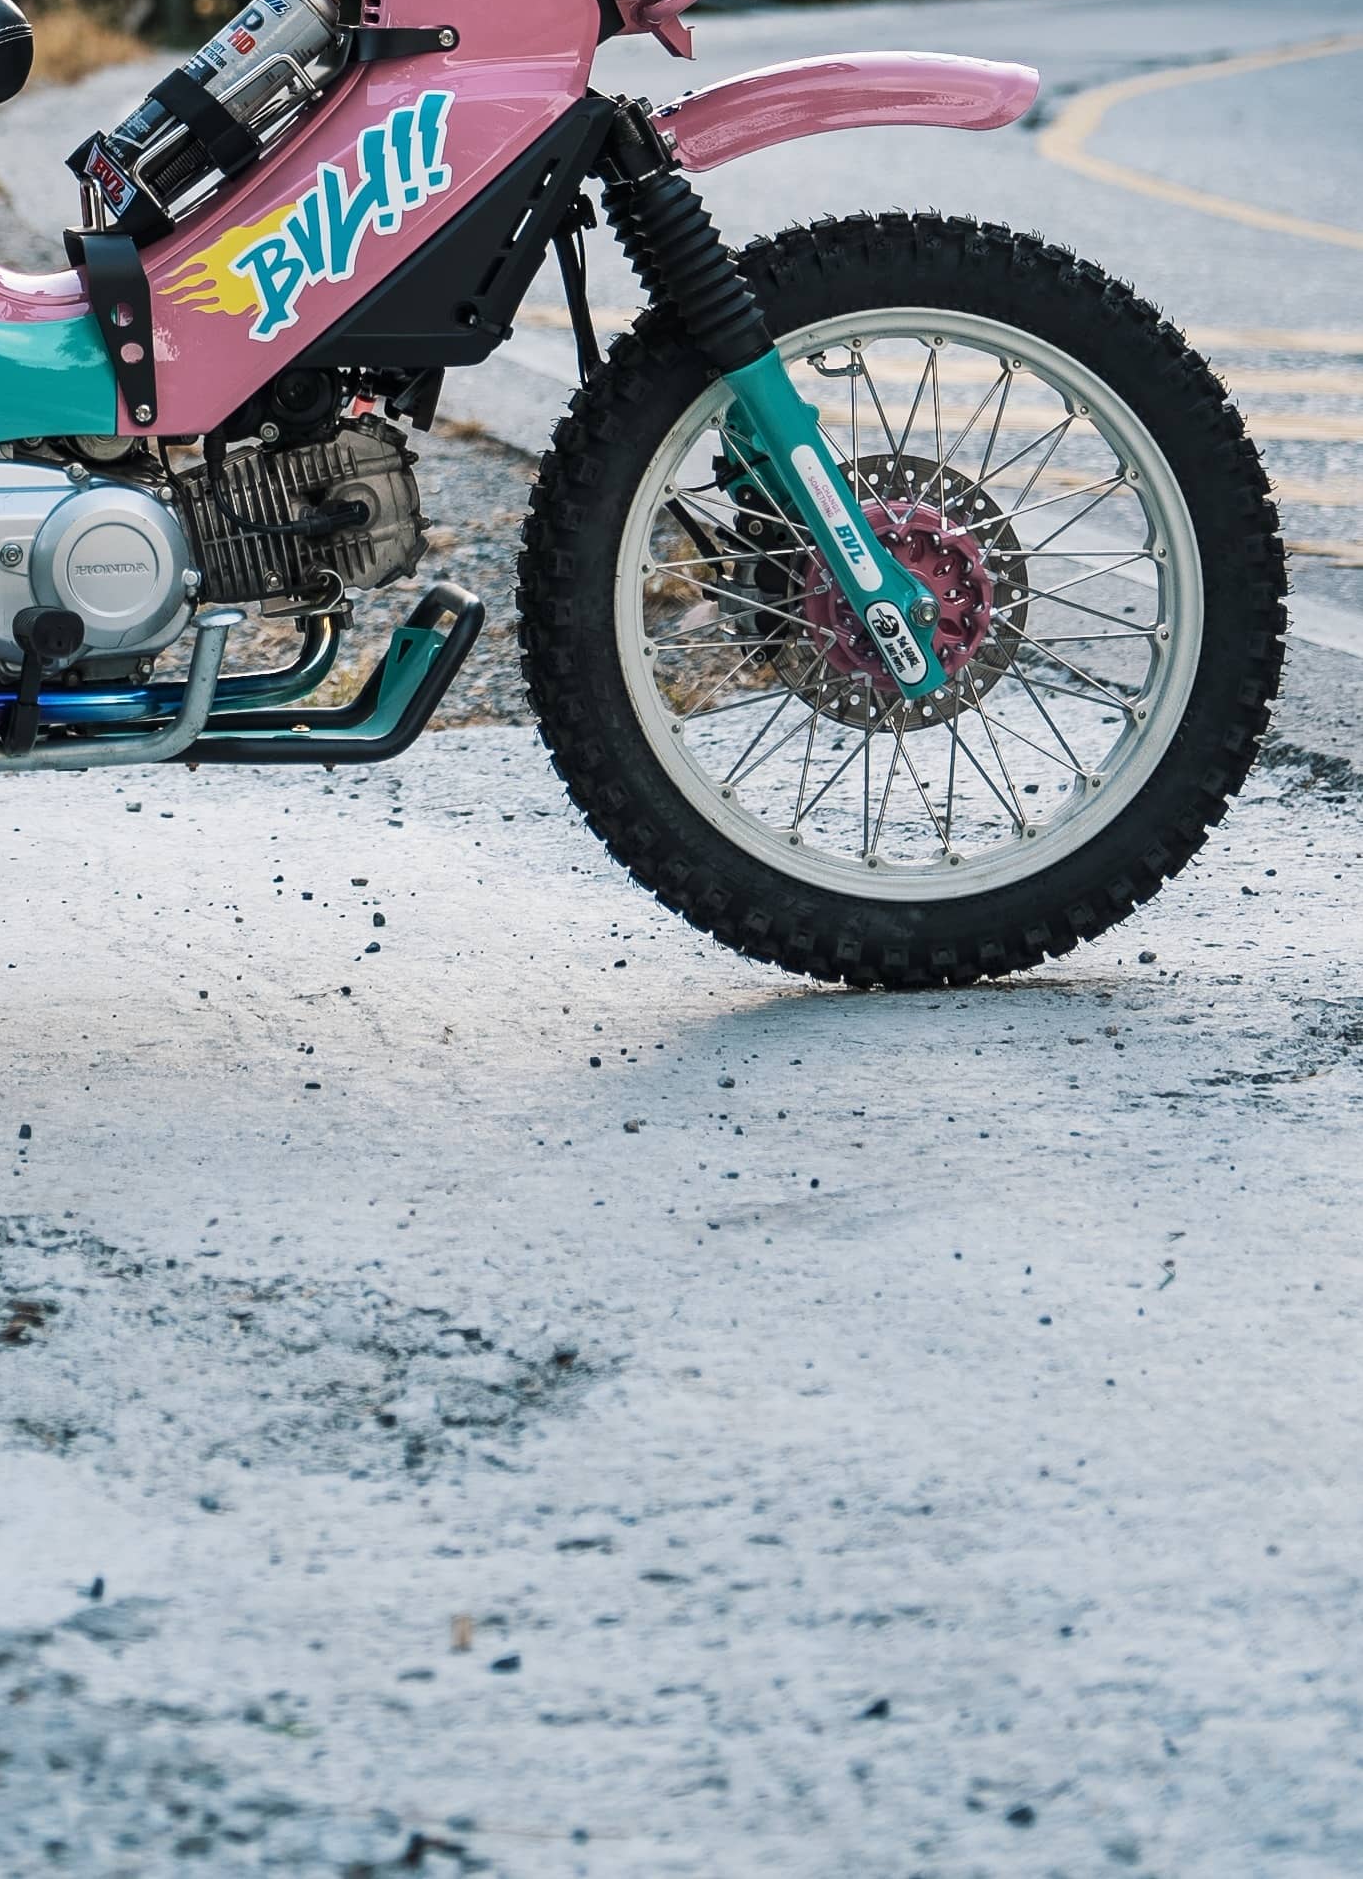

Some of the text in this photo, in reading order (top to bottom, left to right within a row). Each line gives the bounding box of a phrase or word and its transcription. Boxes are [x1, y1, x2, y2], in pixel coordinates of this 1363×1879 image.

[227, 27, 256, 55] HD
[90, 154, 126, 204] BVL
[808, 476, 835, 519] SOMETHING
[821, 484, 842, 515] CHANGE
[835, 523, 866, 565] BVL
[75, 562, 150, 576] HONDA
